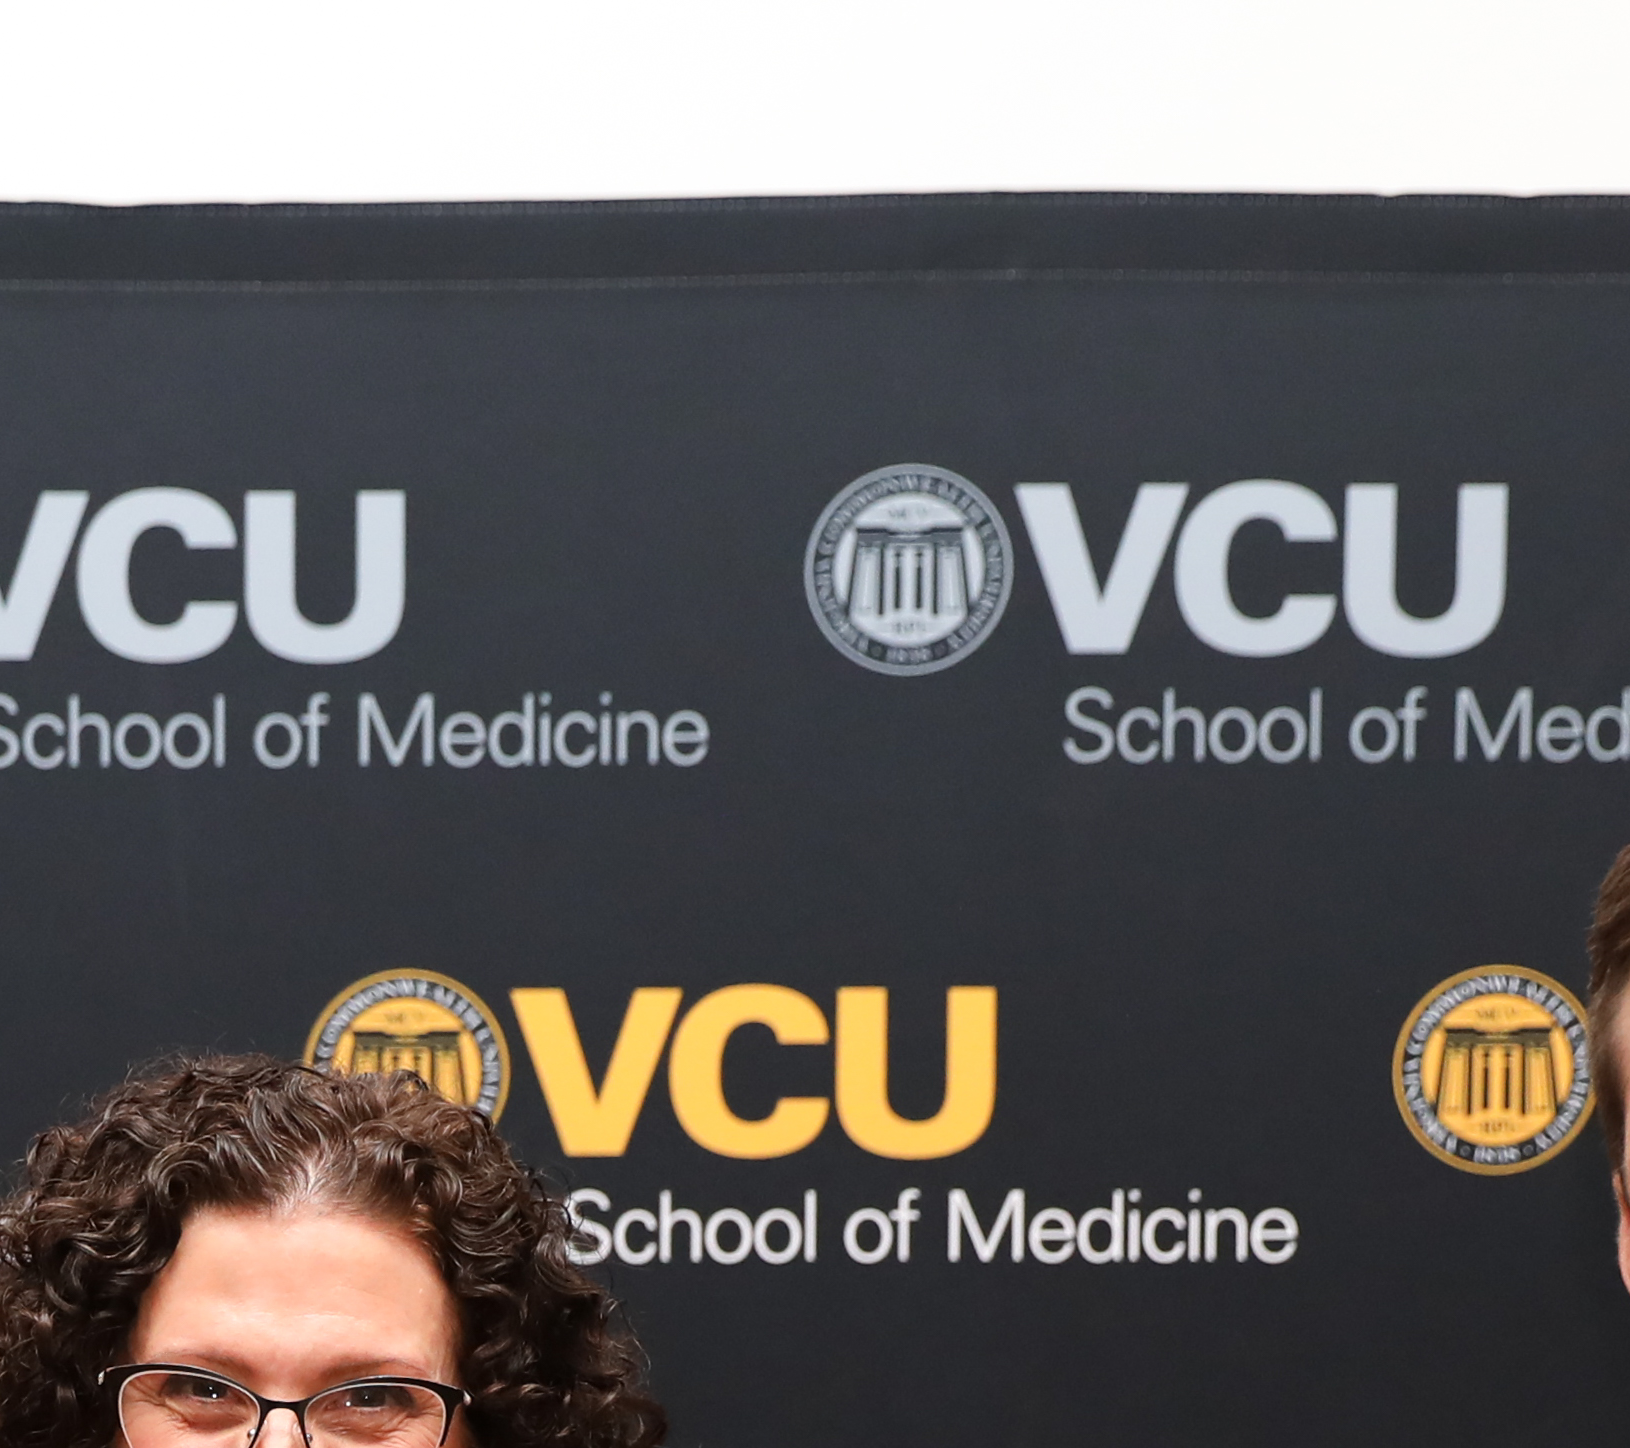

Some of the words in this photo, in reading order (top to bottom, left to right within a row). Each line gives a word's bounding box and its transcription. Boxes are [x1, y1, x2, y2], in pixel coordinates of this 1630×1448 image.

[1014, 479, 1508, 658] VCU
[253, 693, 330, 769] of
[358, 692, 710, 768] Medicine
[1064, 687, 1321, 764] School
[1348, 687, 1426, 763] of
[509, 983, 998, 1160] VCU
[564, 1188, 817, 1265] School
[843, 1187, 921, 1265] of
[948, 1186, 1299, 1265] Medicine
